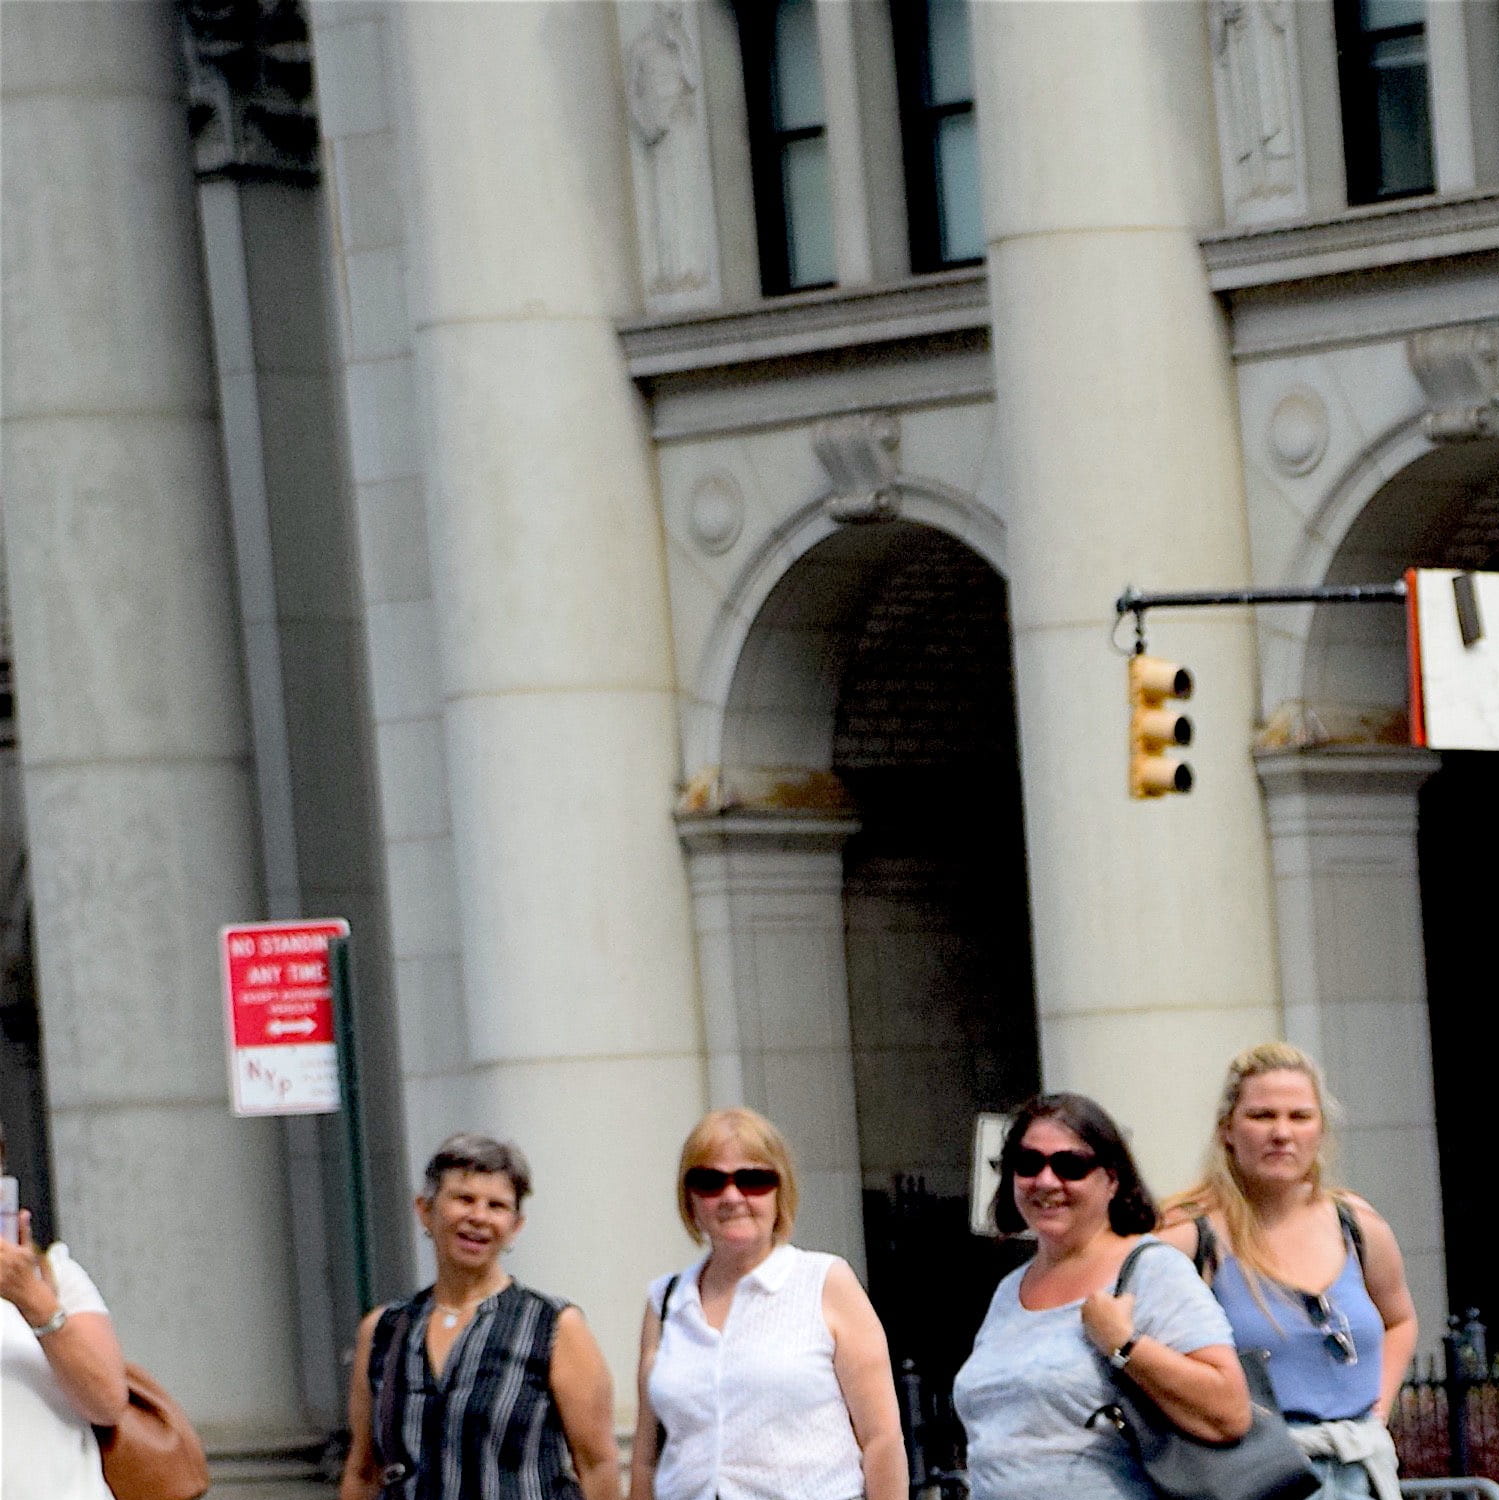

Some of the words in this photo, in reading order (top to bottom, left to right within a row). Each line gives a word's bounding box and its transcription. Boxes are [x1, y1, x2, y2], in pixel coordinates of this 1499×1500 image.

[230, 935, 256, 957] NO
[259, 933, 329, 956] STANDIN
[247, 964, 281, 985] ANY
